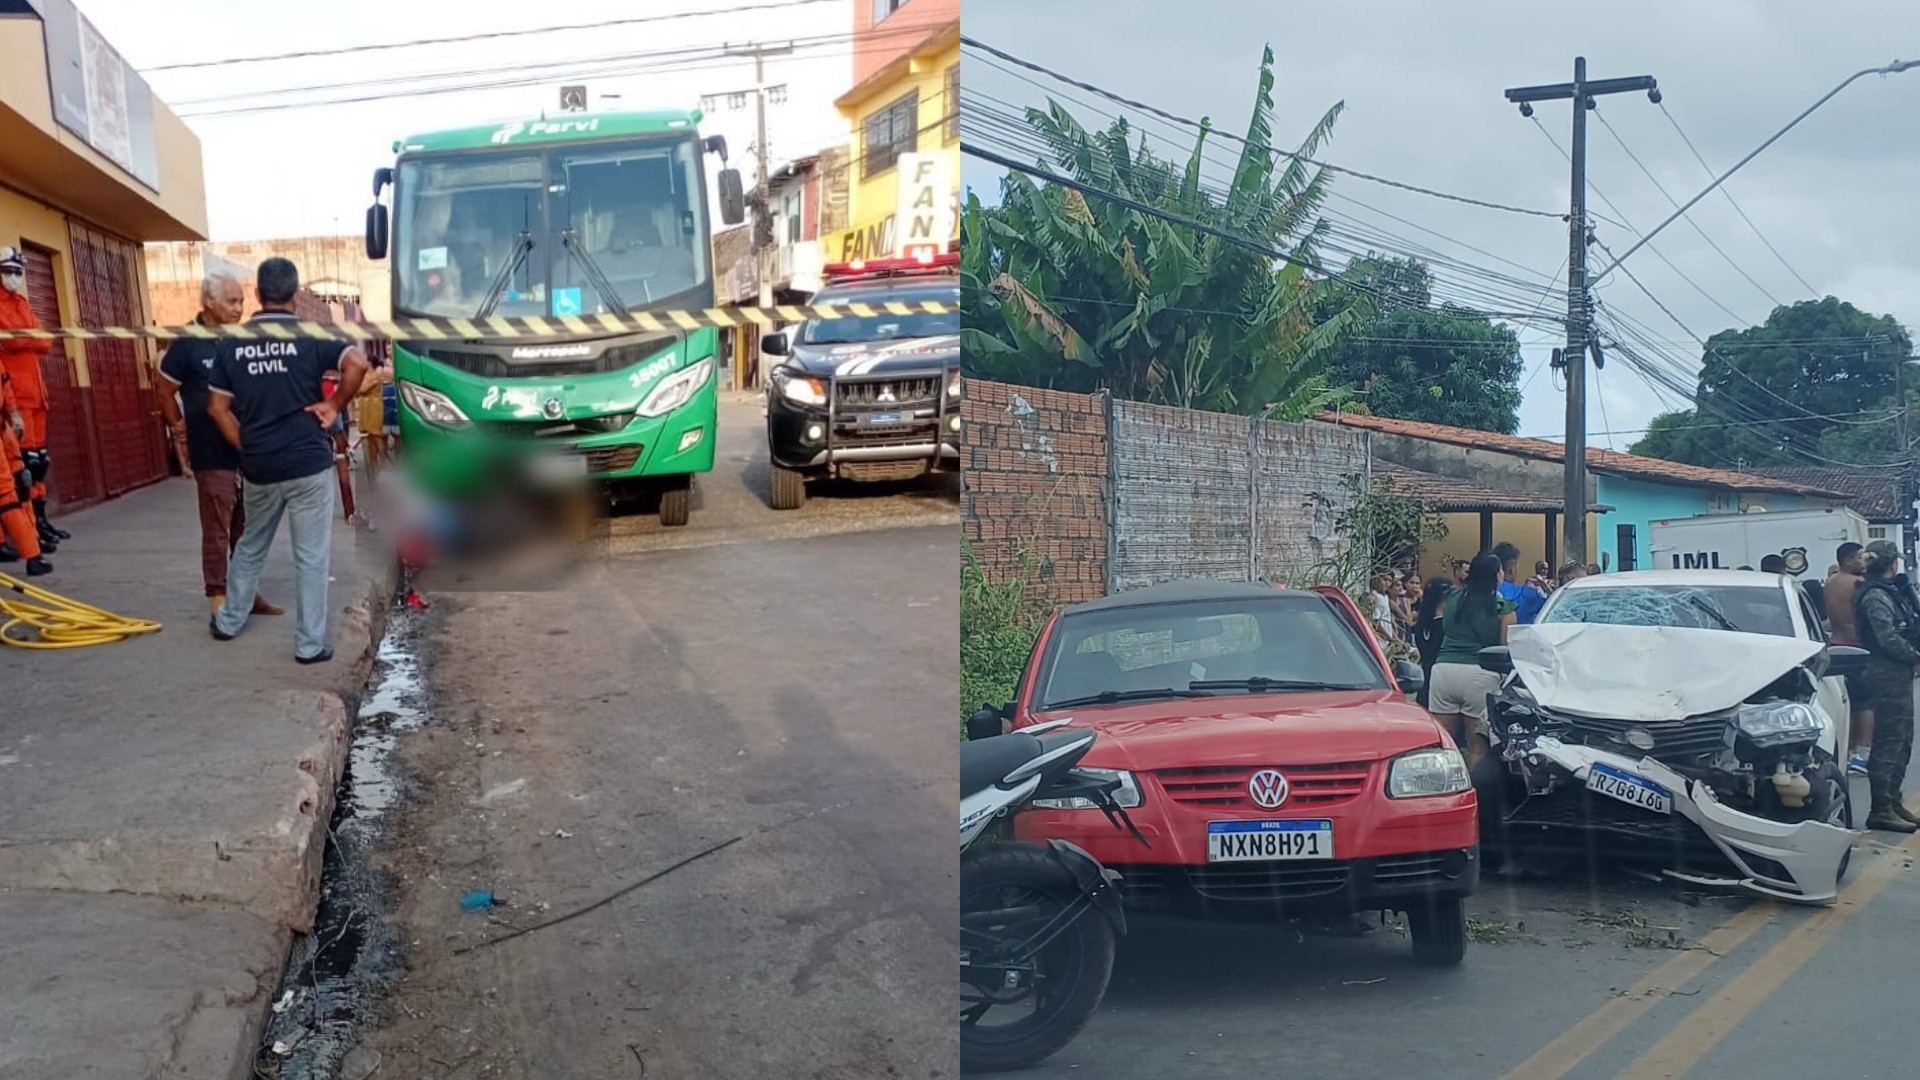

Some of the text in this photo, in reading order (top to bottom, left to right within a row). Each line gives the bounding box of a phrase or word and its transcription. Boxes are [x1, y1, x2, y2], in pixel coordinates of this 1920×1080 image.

[529, 118, 599, 135] Parvi
[235, 341, 298, 360] POLÍCIA
[247, 360, 288, 375] CIVIL
[1672, 551, 1730, 570] IML
[1220, 832, 1320, 858] NXN8H91
